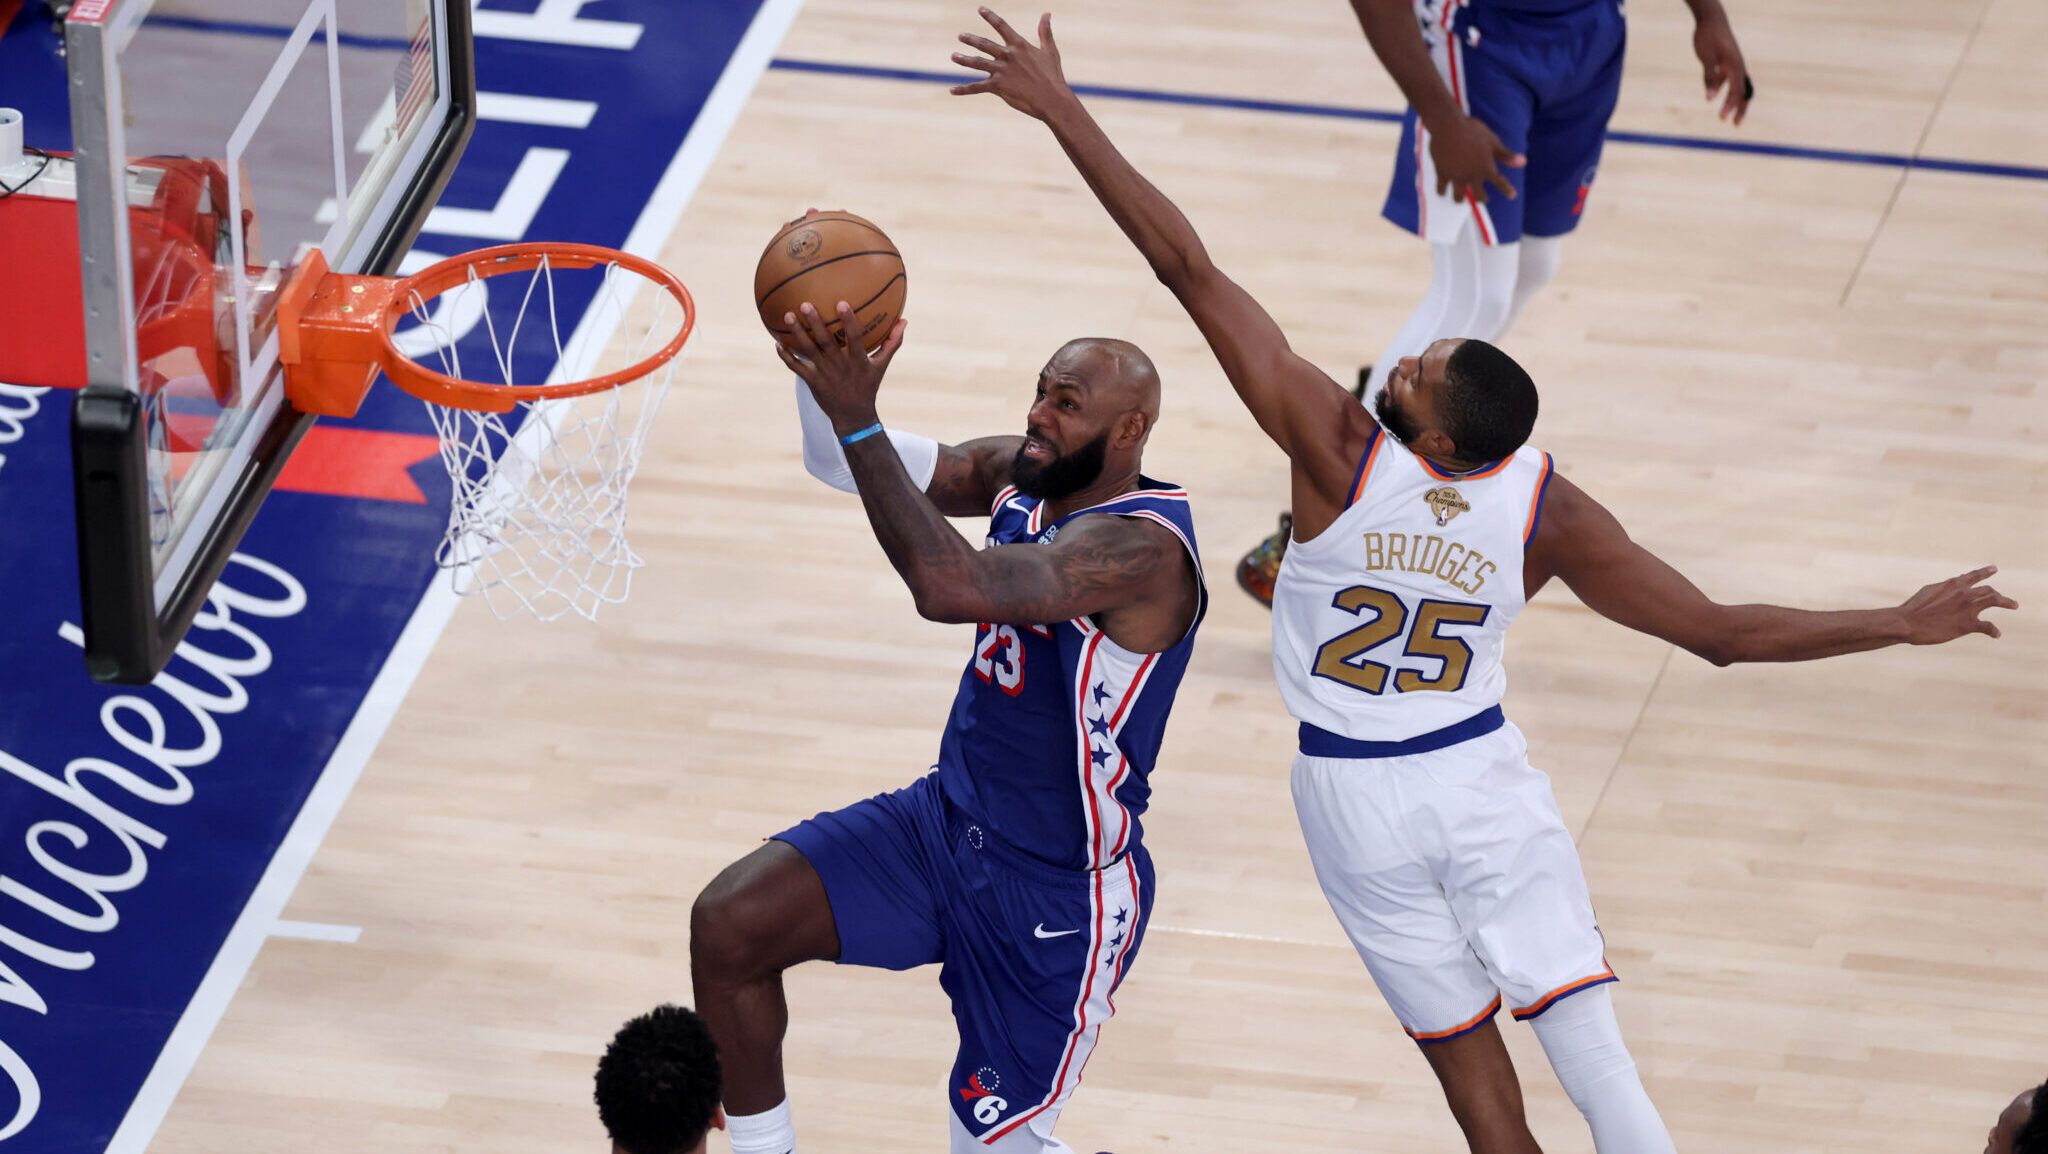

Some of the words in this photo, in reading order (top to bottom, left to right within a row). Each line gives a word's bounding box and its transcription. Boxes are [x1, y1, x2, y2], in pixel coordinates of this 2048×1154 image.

[1363, 532, 1497, 595] BRIDGES
[975, 623, 1026, 698] 23
[1311, 584, 1492, 696] 25
